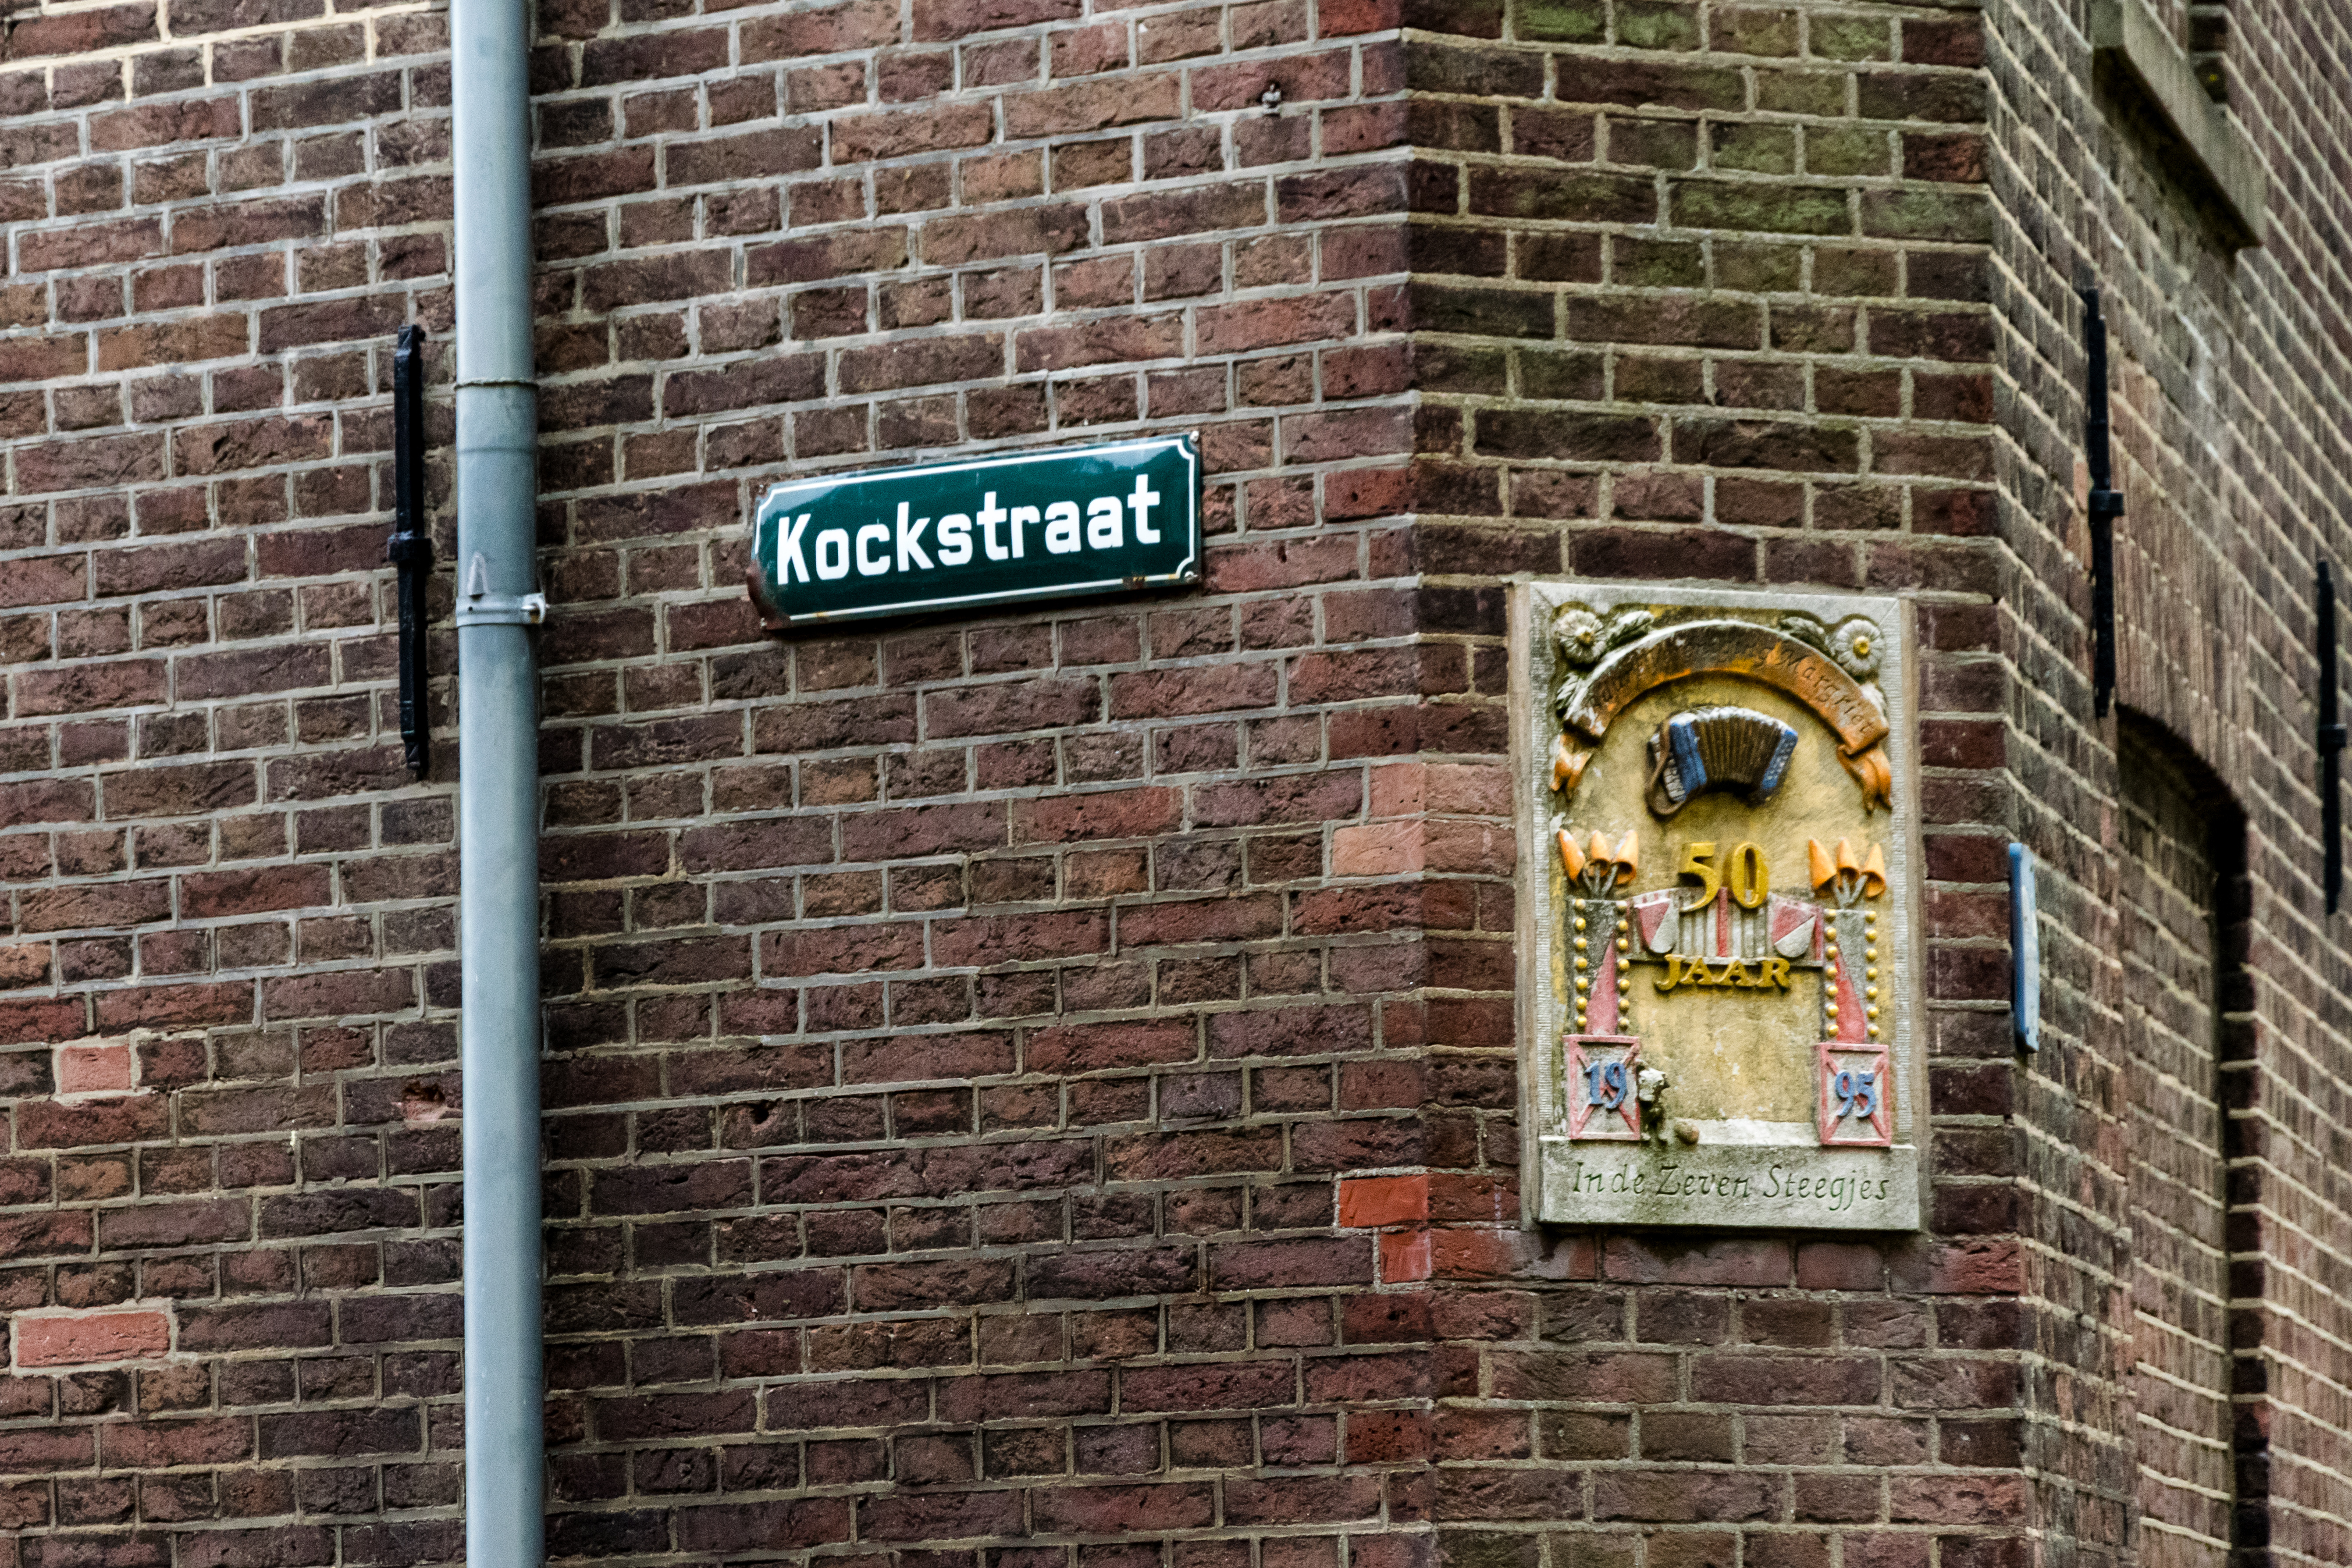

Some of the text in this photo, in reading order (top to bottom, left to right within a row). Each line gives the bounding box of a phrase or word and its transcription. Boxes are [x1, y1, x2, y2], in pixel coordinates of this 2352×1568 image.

[777, 474, 1160, 585] Kockstraat
[1775, 649, 1874, 732] Margriet
[1679, 842, 1770, 913] 50
[1654, 953, 1791, 991] JAAR
[1583, 1061, 1628, 1110] 19
[1834, 1070, 1878, 1119] 95
[1655, 1165, 1751, 1198] Zeven
[1763, 1164, 1890, 1211] Steegjes
